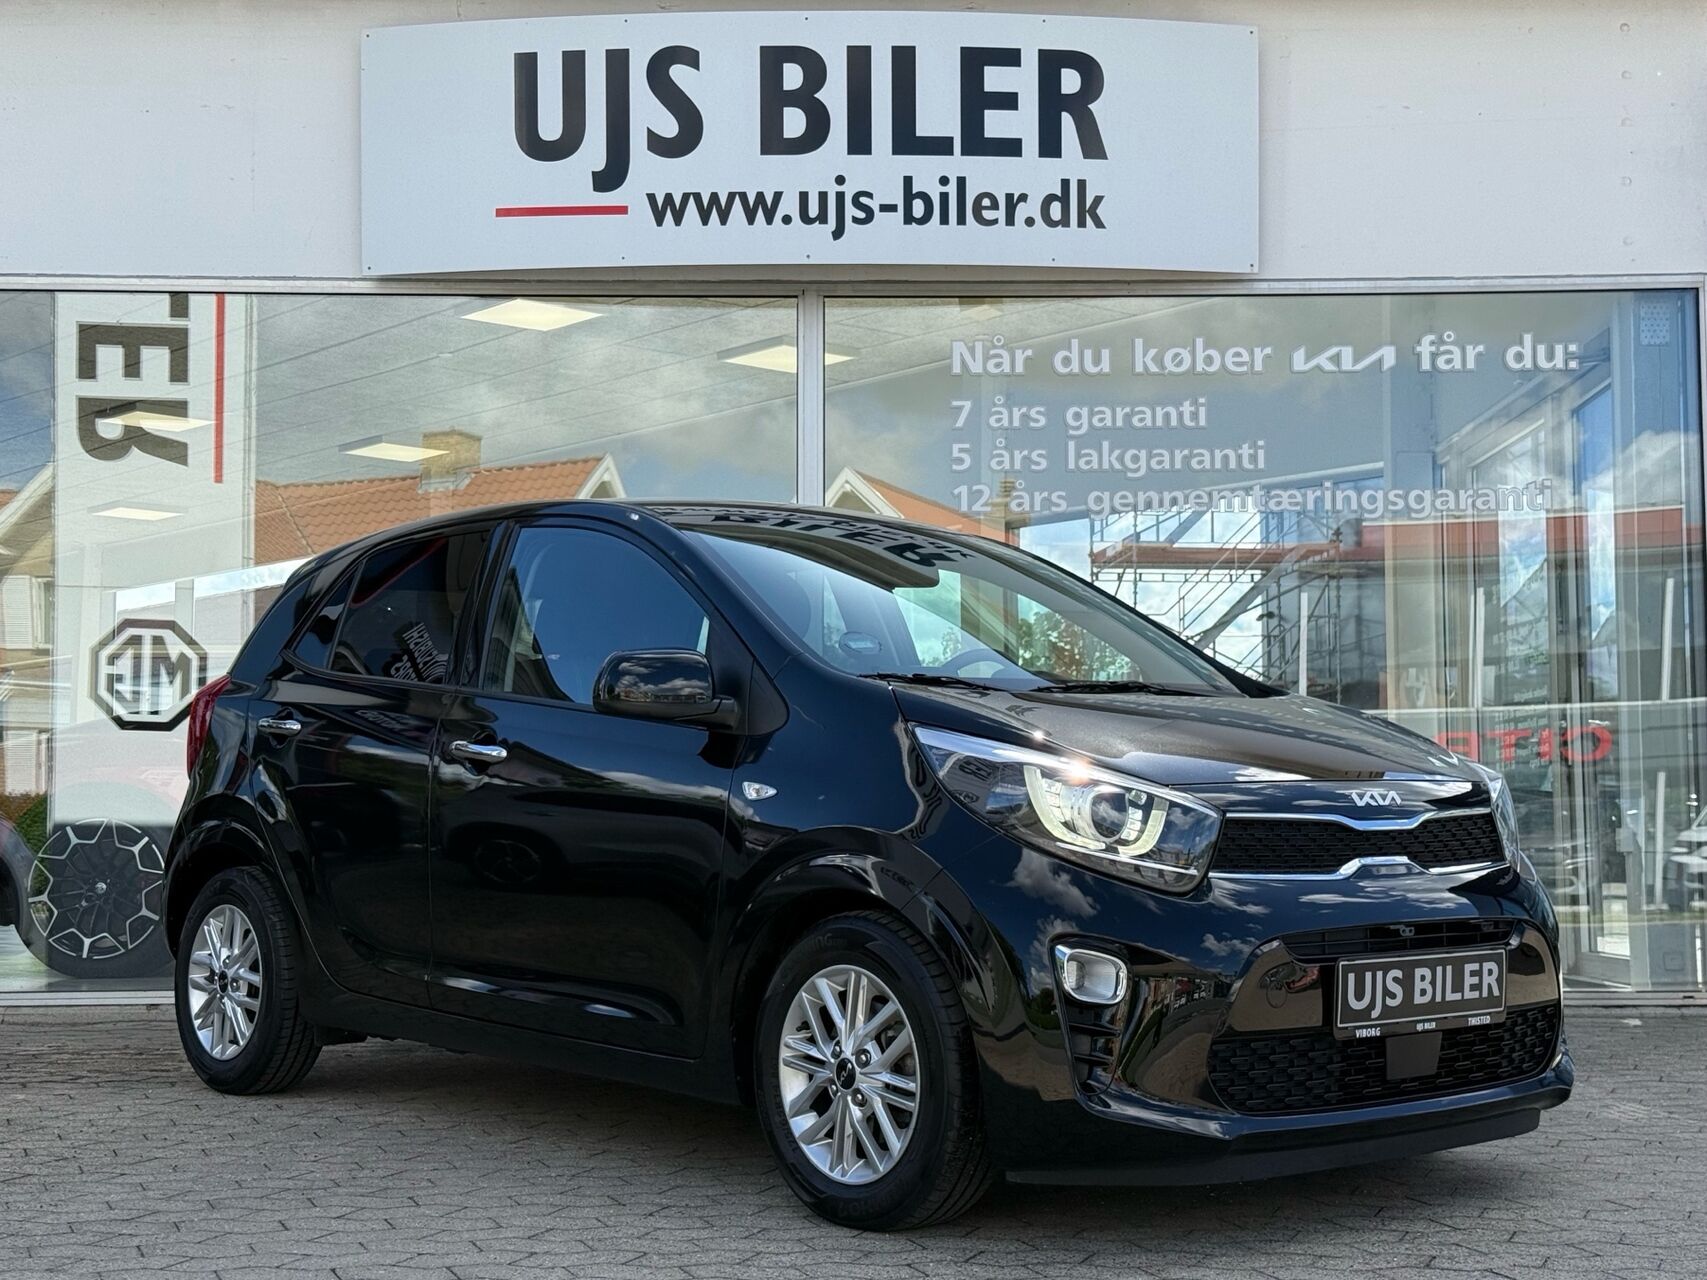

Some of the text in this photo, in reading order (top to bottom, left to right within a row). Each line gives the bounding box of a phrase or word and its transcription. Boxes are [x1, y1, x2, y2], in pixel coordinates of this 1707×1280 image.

[513, 45, 1108, 193] UJS BILER
[645, 175, 1107, 242] www.ujs-biler.dk
[951, 336, 1033, 375] Når
[1053, 338, 1111, 375] du
[1132, 338, 1272, 376] køber
[1414, 331, 1485, 372] får
[1505, 334, 1580, 371] du:
[951, 397, 1208, 436] 7 års garanti
[951, 438, 1266, 477] 5 års lakgaranti
[953, 479, 1554, 520] 12 års gennemtæringsgaranti
[1347, 961, 1501, 1019] UJS BILER
[1355, 1027, 1381, 1039] VIBORG
